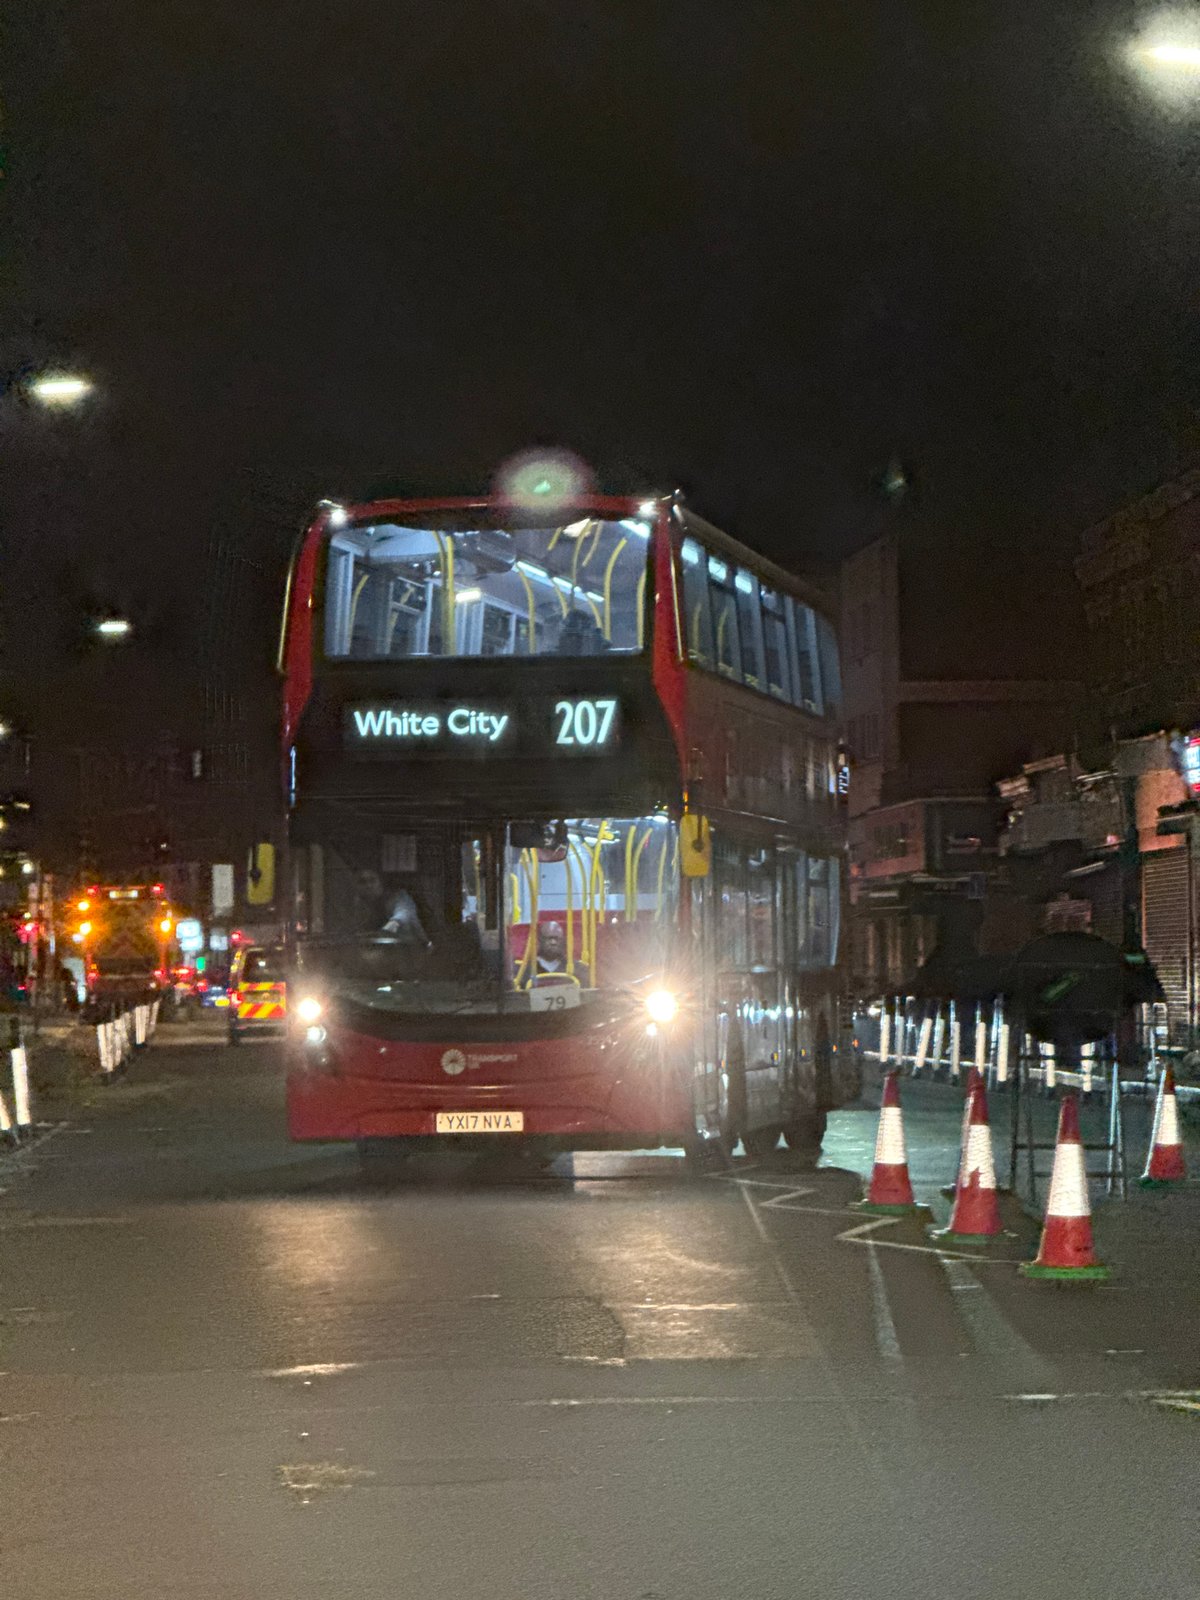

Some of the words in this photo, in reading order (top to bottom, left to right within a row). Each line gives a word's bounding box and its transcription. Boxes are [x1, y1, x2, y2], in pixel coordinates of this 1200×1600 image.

[353, 710, 439, 737] White
[447, 708, 509, 741] City
[554, 700, 617, 745] 207
[544, 995, 567, 1011] 79
[446, 1115, 479, 1130] YX17
[483, 1114, 512, 1129] NVA
